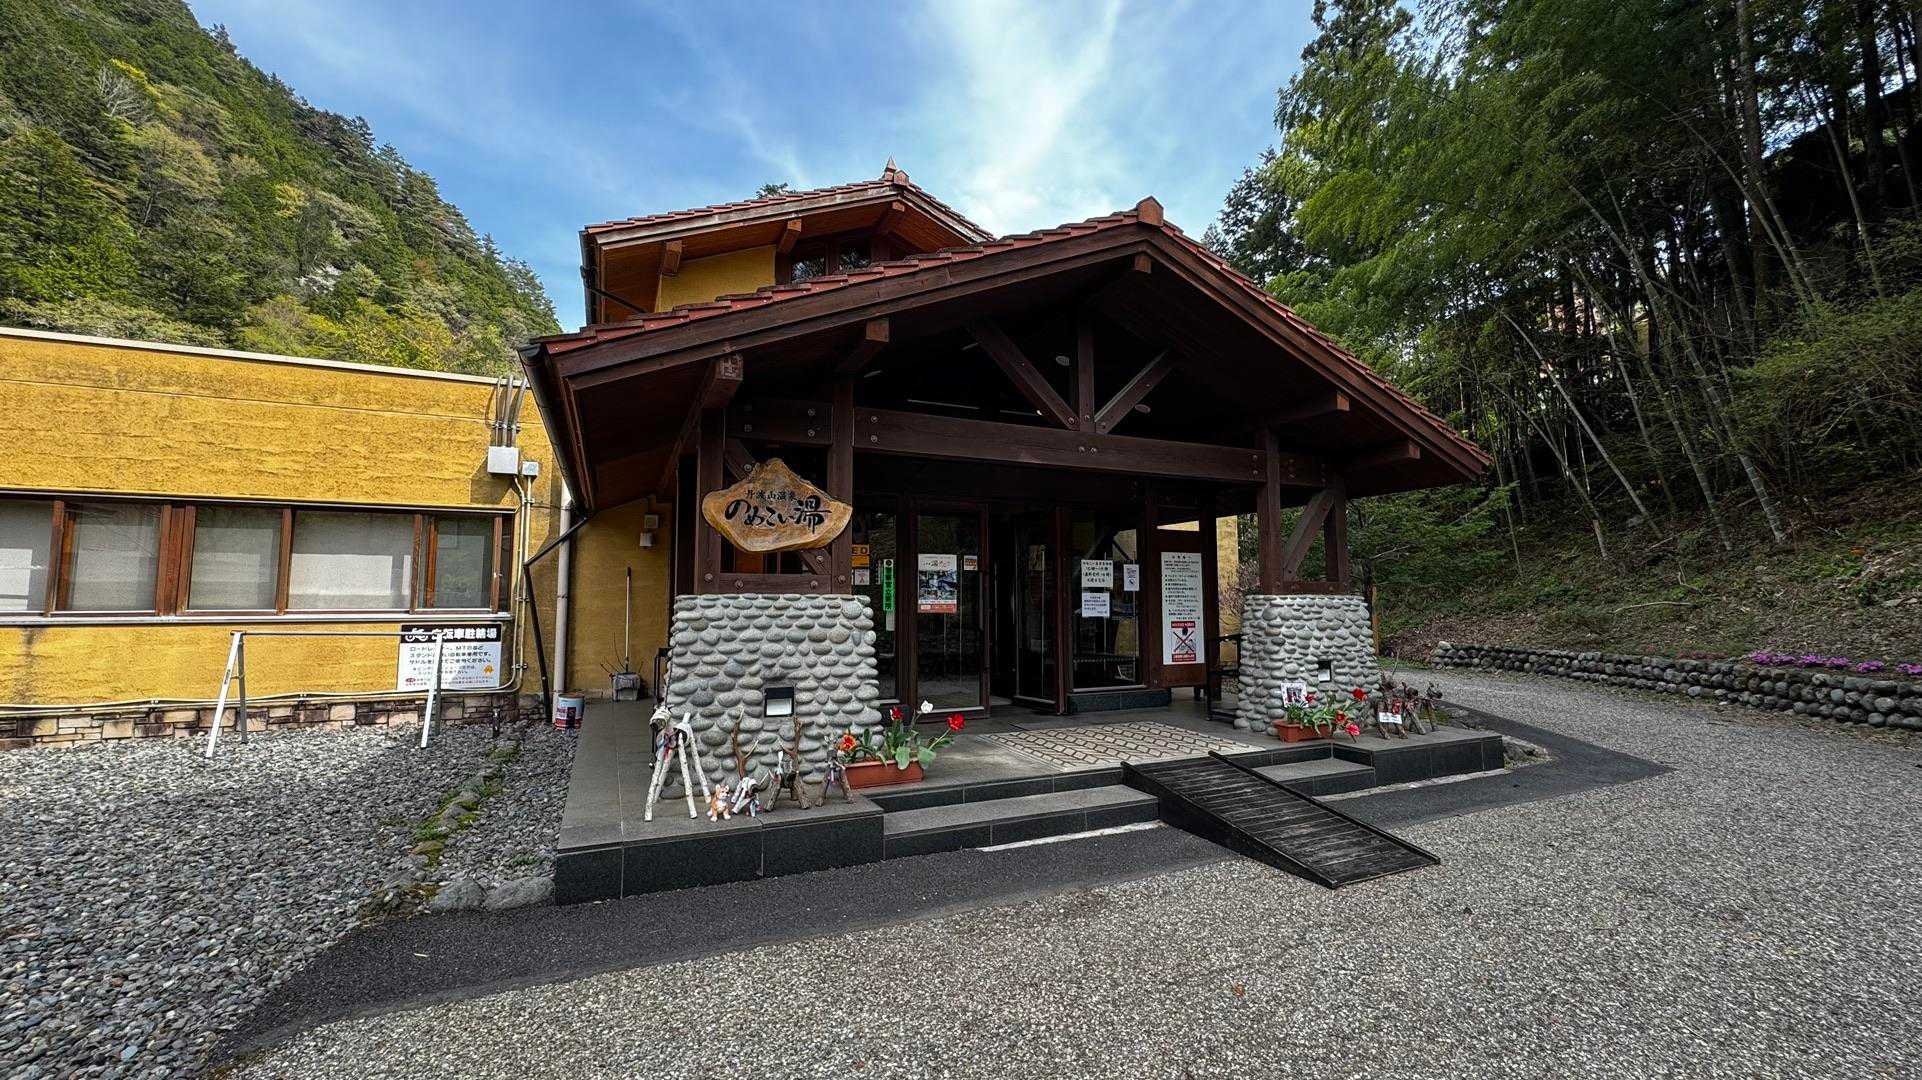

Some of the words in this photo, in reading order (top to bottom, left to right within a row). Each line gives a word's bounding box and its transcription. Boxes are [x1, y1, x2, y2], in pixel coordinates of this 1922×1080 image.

[724, 495, 833, 534] のめこい湯
